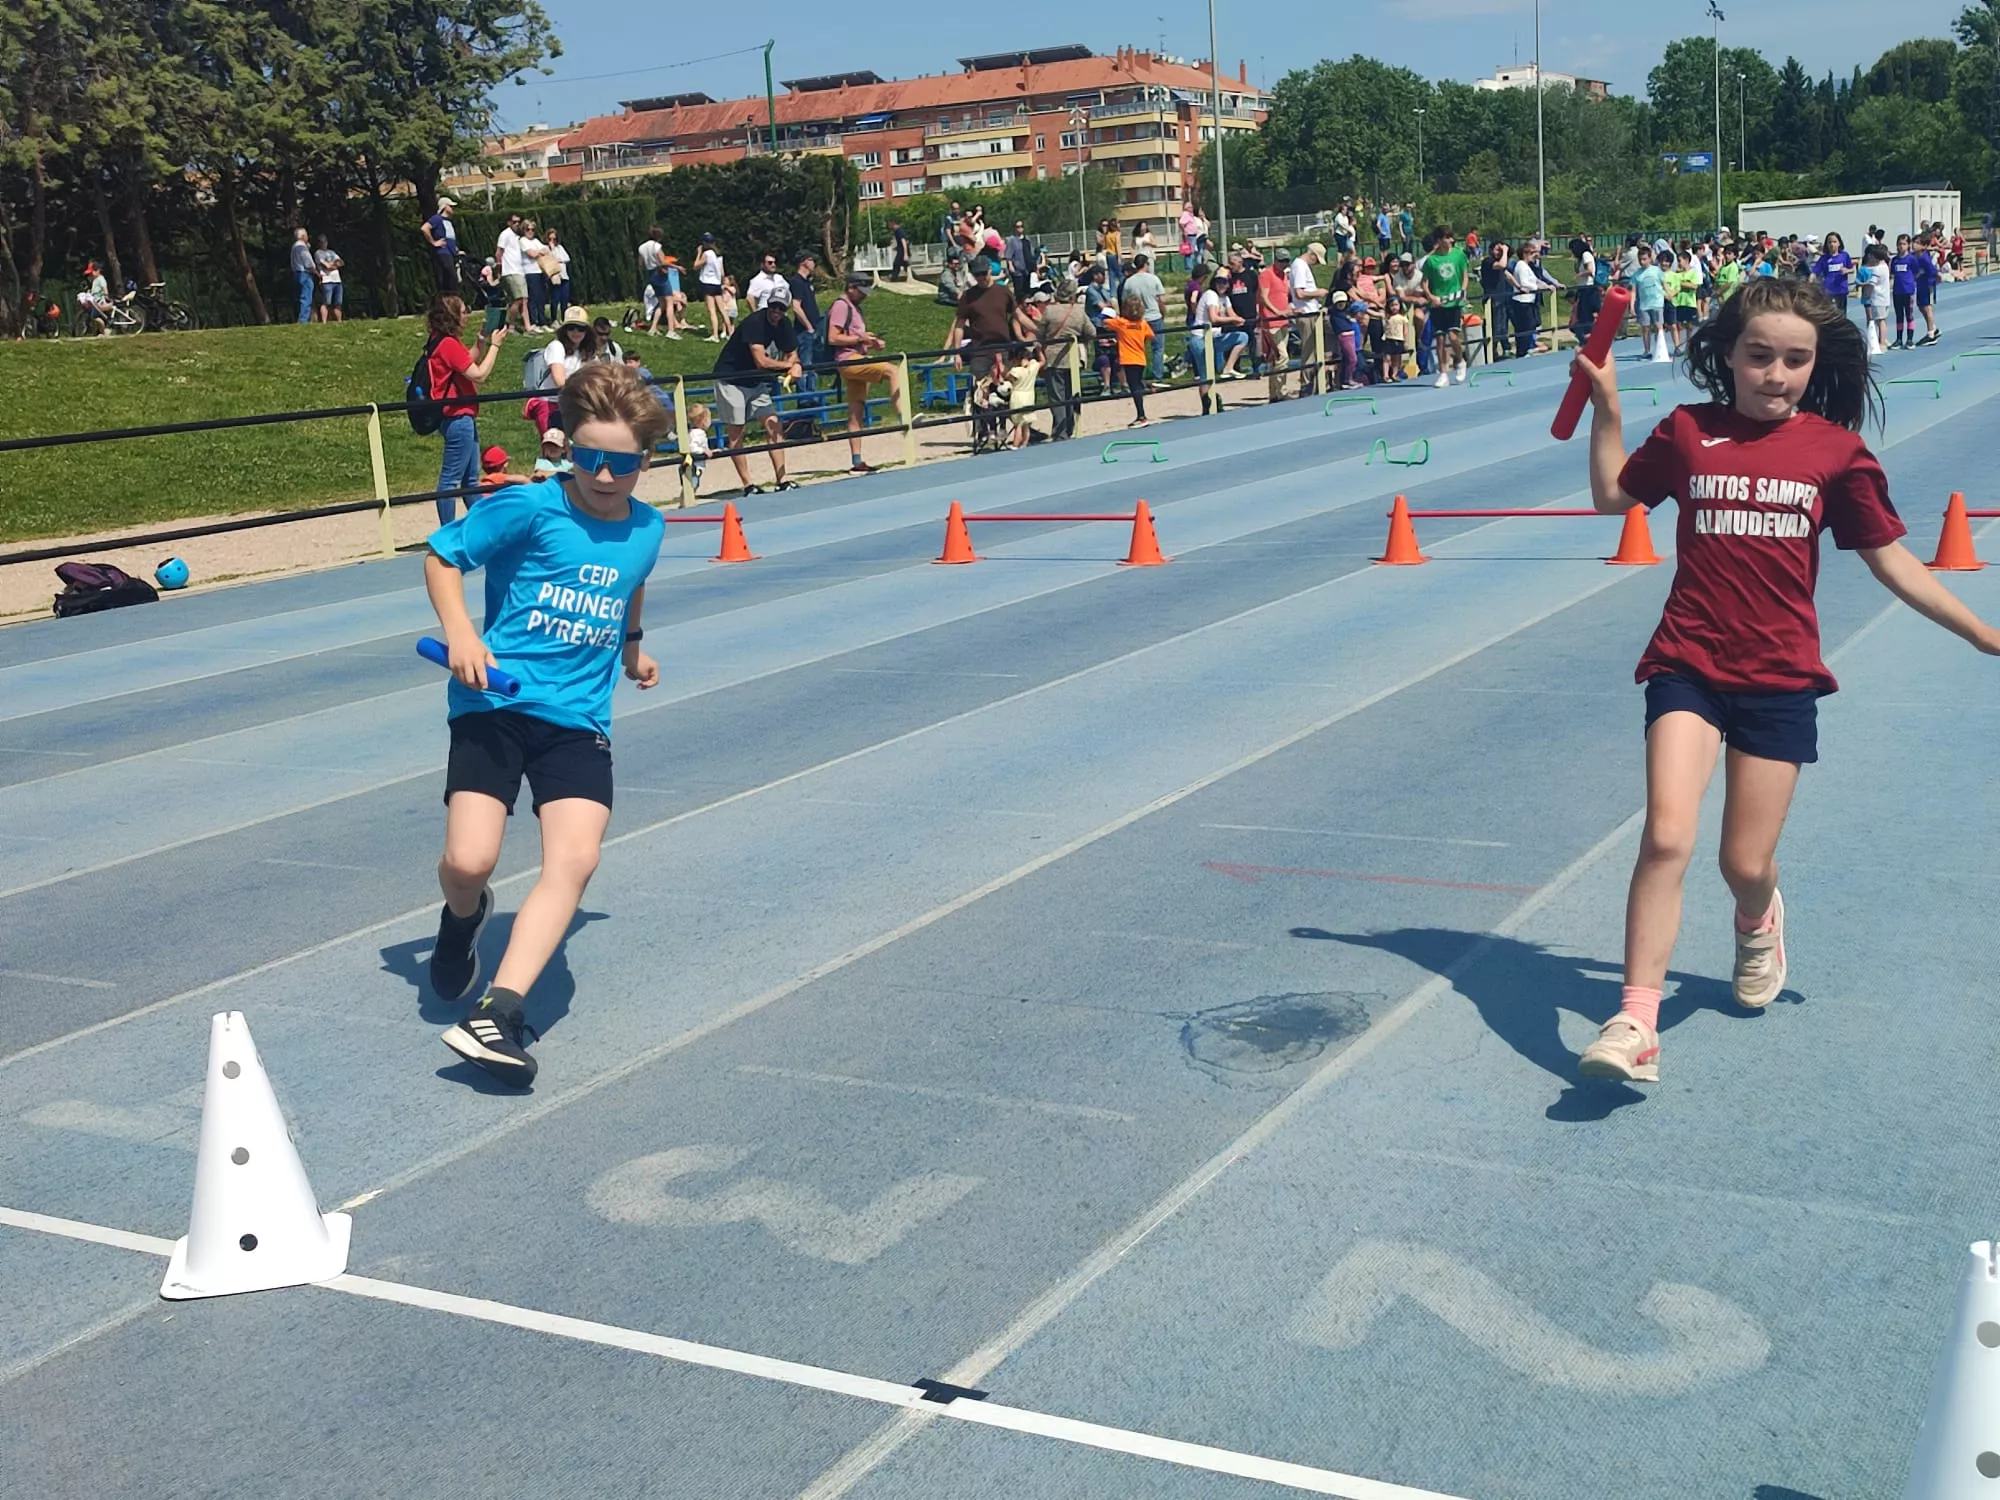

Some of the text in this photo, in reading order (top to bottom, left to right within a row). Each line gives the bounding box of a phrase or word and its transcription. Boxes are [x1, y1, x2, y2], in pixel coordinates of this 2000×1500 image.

[1689, 474, 1750, 501] SANTOS
[579, 564, 619, 588] CEIP
[538, 581, 627, 620] PIRINEO
[527, 609, 620, 651] PYRÉNÉE
